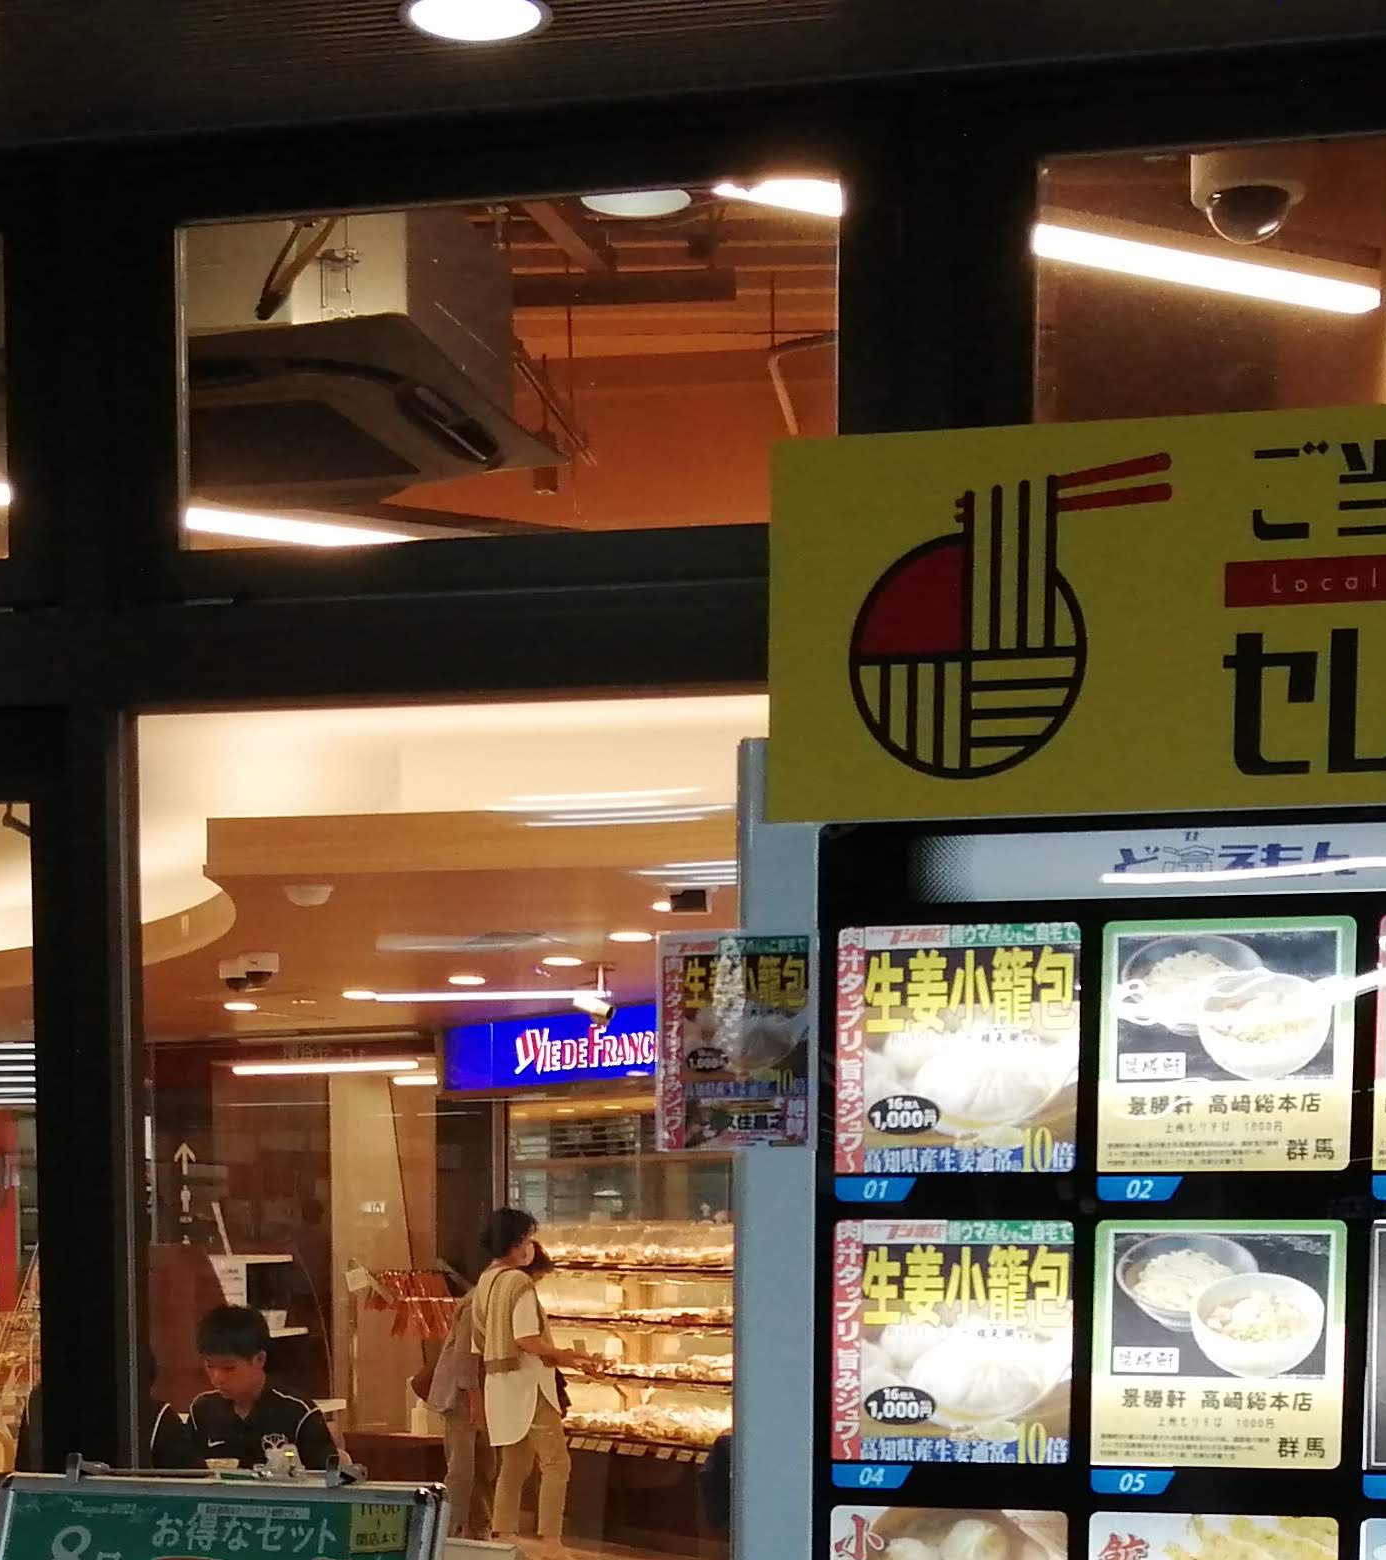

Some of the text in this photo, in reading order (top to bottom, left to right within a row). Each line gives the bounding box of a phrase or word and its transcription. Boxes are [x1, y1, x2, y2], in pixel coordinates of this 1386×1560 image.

[1271, 571, 1379, 596] Local
[864, 945, 1078, 1034] 生姜小籠包
[1207, 1092, 1322, 1114] 高崎総本店
[871, 1108, 938, 1131] 1,000円
[1285, 1137, 1336, 1161] 群馬
[862, 1180, 890, 1200] 01
[1124, 1180, 1154, 1200] 02
[863, 1244, 1071, 1328] 生姜小籠包
[867, 1400, 933, 1420] 1,000円
[1201, 1390, 1313, 1412] 高崎総本店
[1278, 1436, 1326, 1459] 群馬
[858, 1467, 885, 1486] 04
[1118, 1472, 1147, 1492] 05
[151, 1513, 336, 1554] お得なセット
